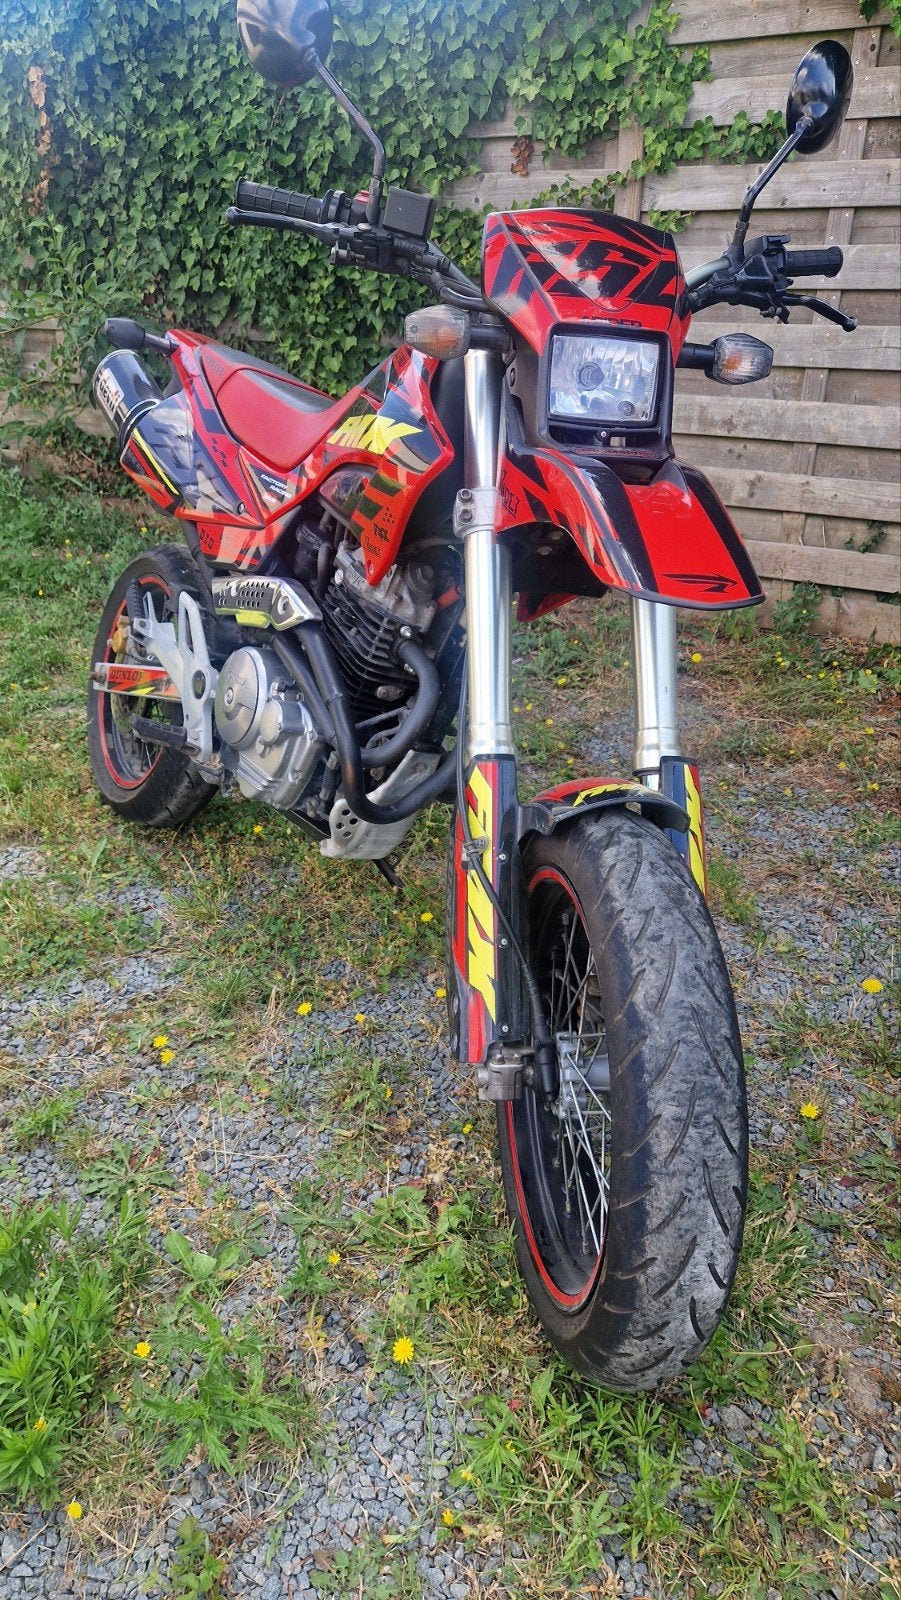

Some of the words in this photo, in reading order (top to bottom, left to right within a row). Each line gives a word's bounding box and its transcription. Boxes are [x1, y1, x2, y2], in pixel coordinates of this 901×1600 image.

[260, 473, 289, 490] FACTORY
[269, 484, 292, 499] RACING
[109, 667, 144, 682] DUNLOP
